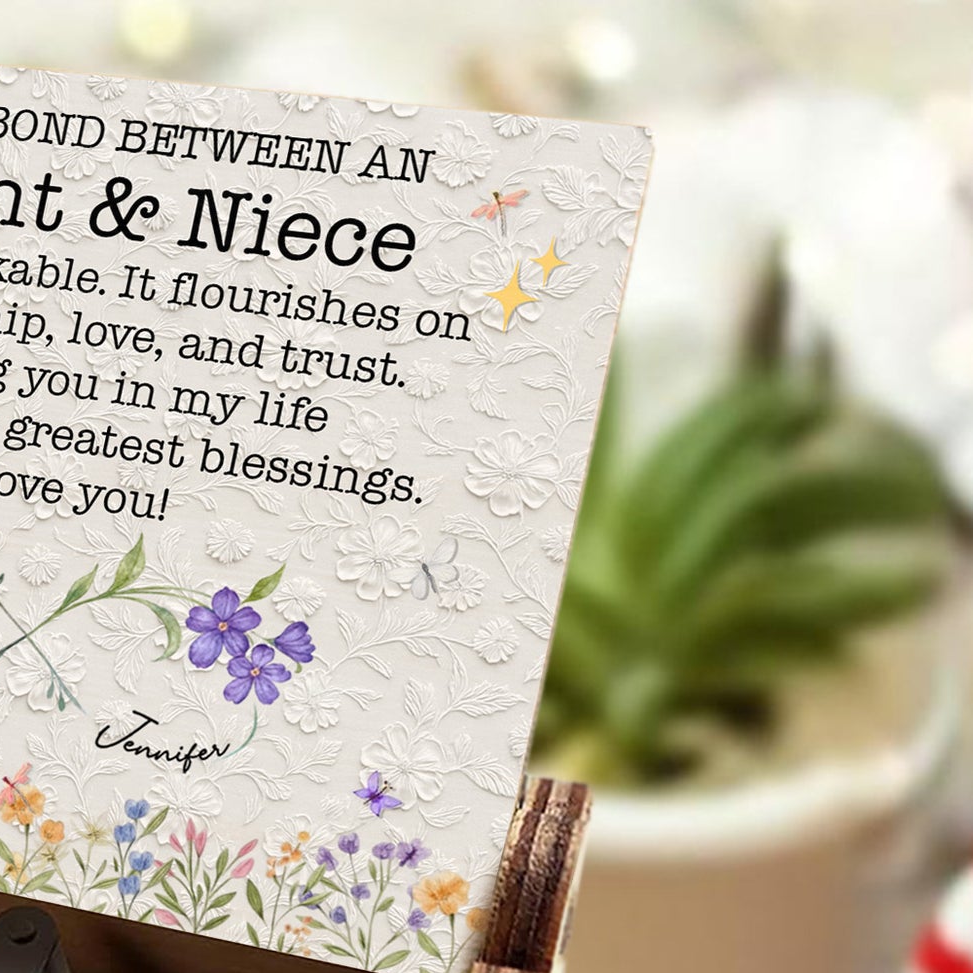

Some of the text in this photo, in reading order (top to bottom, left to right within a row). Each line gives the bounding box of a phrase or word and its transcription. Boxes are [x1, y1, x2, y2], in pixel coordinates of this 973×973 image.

[114, 118, 352, 175] BETWEEN
[357, 144, 437, 184] AN
[89, 176, 160, 242] &
[176, 187, 416, 273] Niece
[118, 264, 156, 302] It
[167, 272, 401, 332] flourishes
[415, 309, 472, 342] on
[66, 310, 163, 362] love,
[178, 333, 265, 370] and
[280, 339, 405, 388] trust.
[17, 366, 99, 401] you
[110, 370, 156, 410] in
[168, 386, 246, 426] my
[253, 390, 329, 433] life
[3, 415, 185, 469] greatest
[200, 437, 422, 505] blessings.
[72, 482, 170, 522] you!
[94, 710, 232, 775] Jennifer
